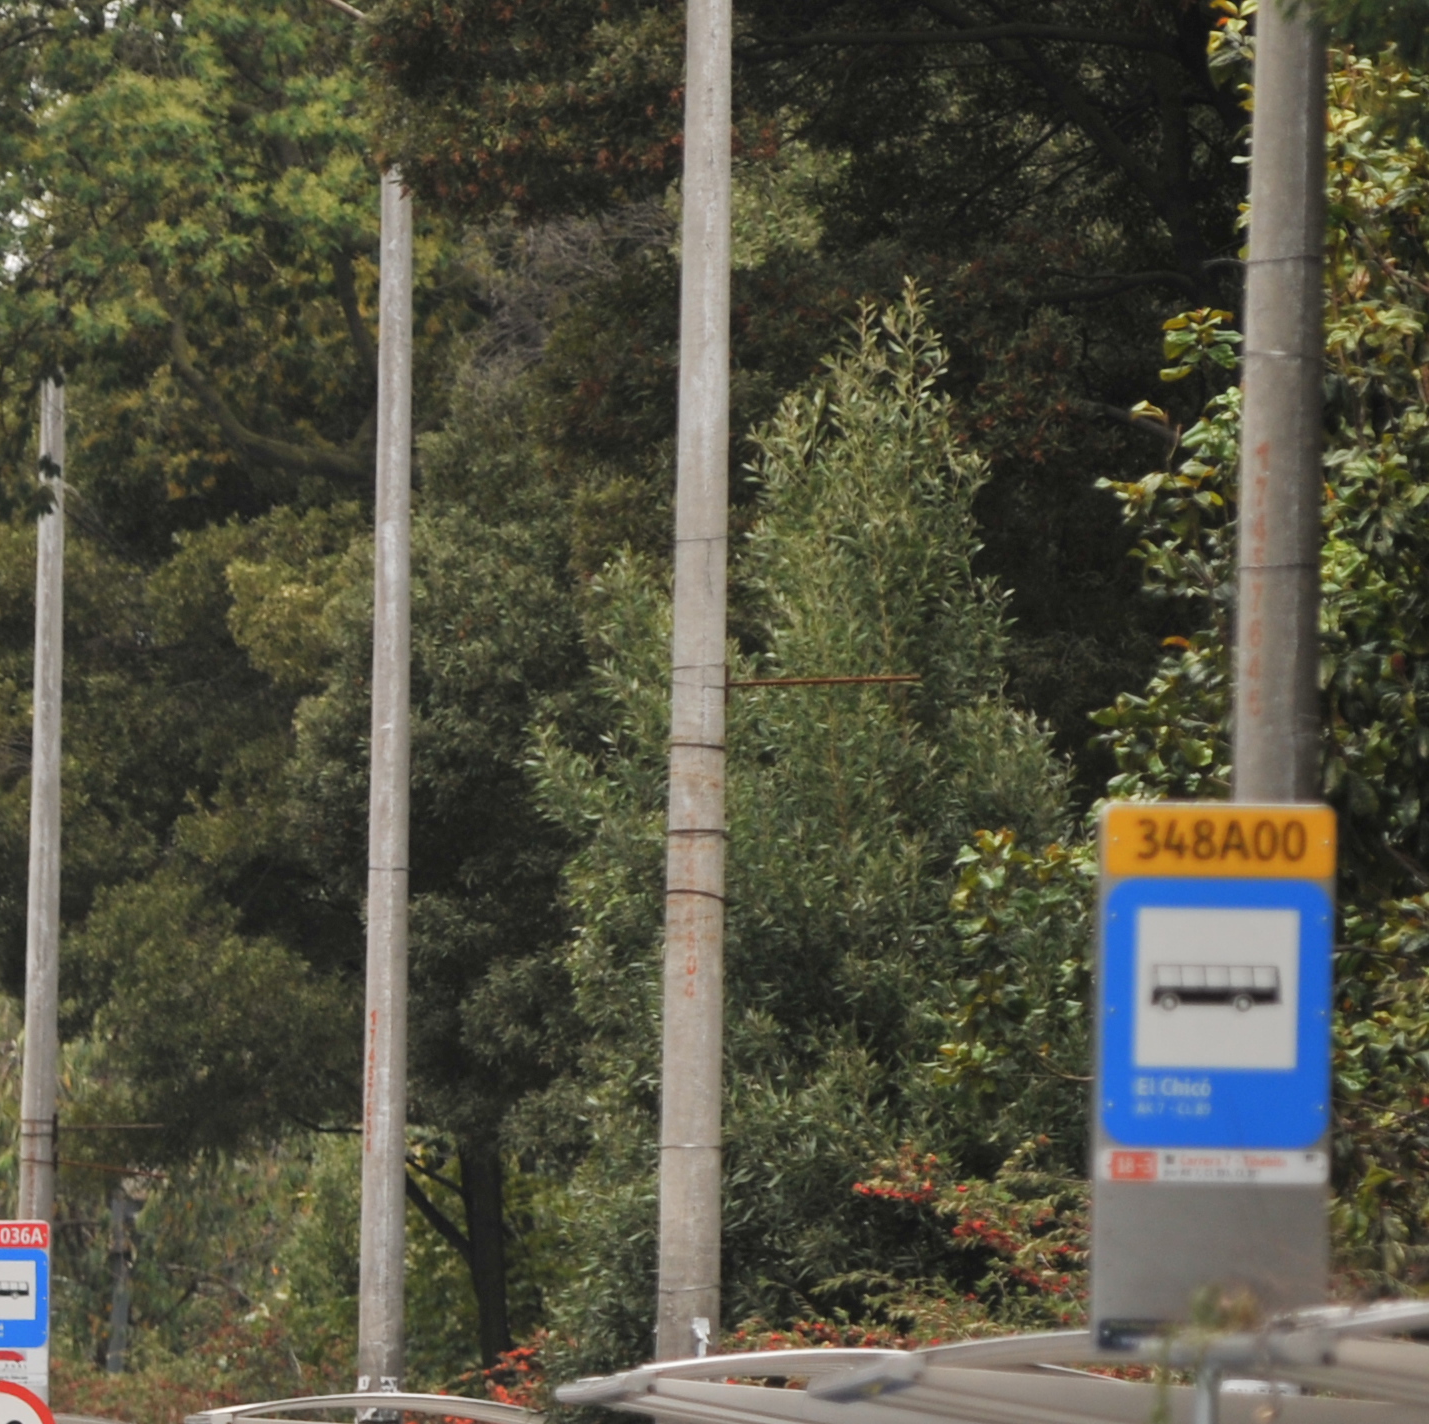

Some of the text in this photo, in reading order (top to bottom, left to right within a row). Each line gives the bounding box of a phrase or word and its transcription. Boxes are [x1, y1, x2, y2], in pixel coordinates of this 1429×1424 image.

[1136, 817, 1309, 863] 348A00
[1135, 1077, 1212, 1097] El Chicó
